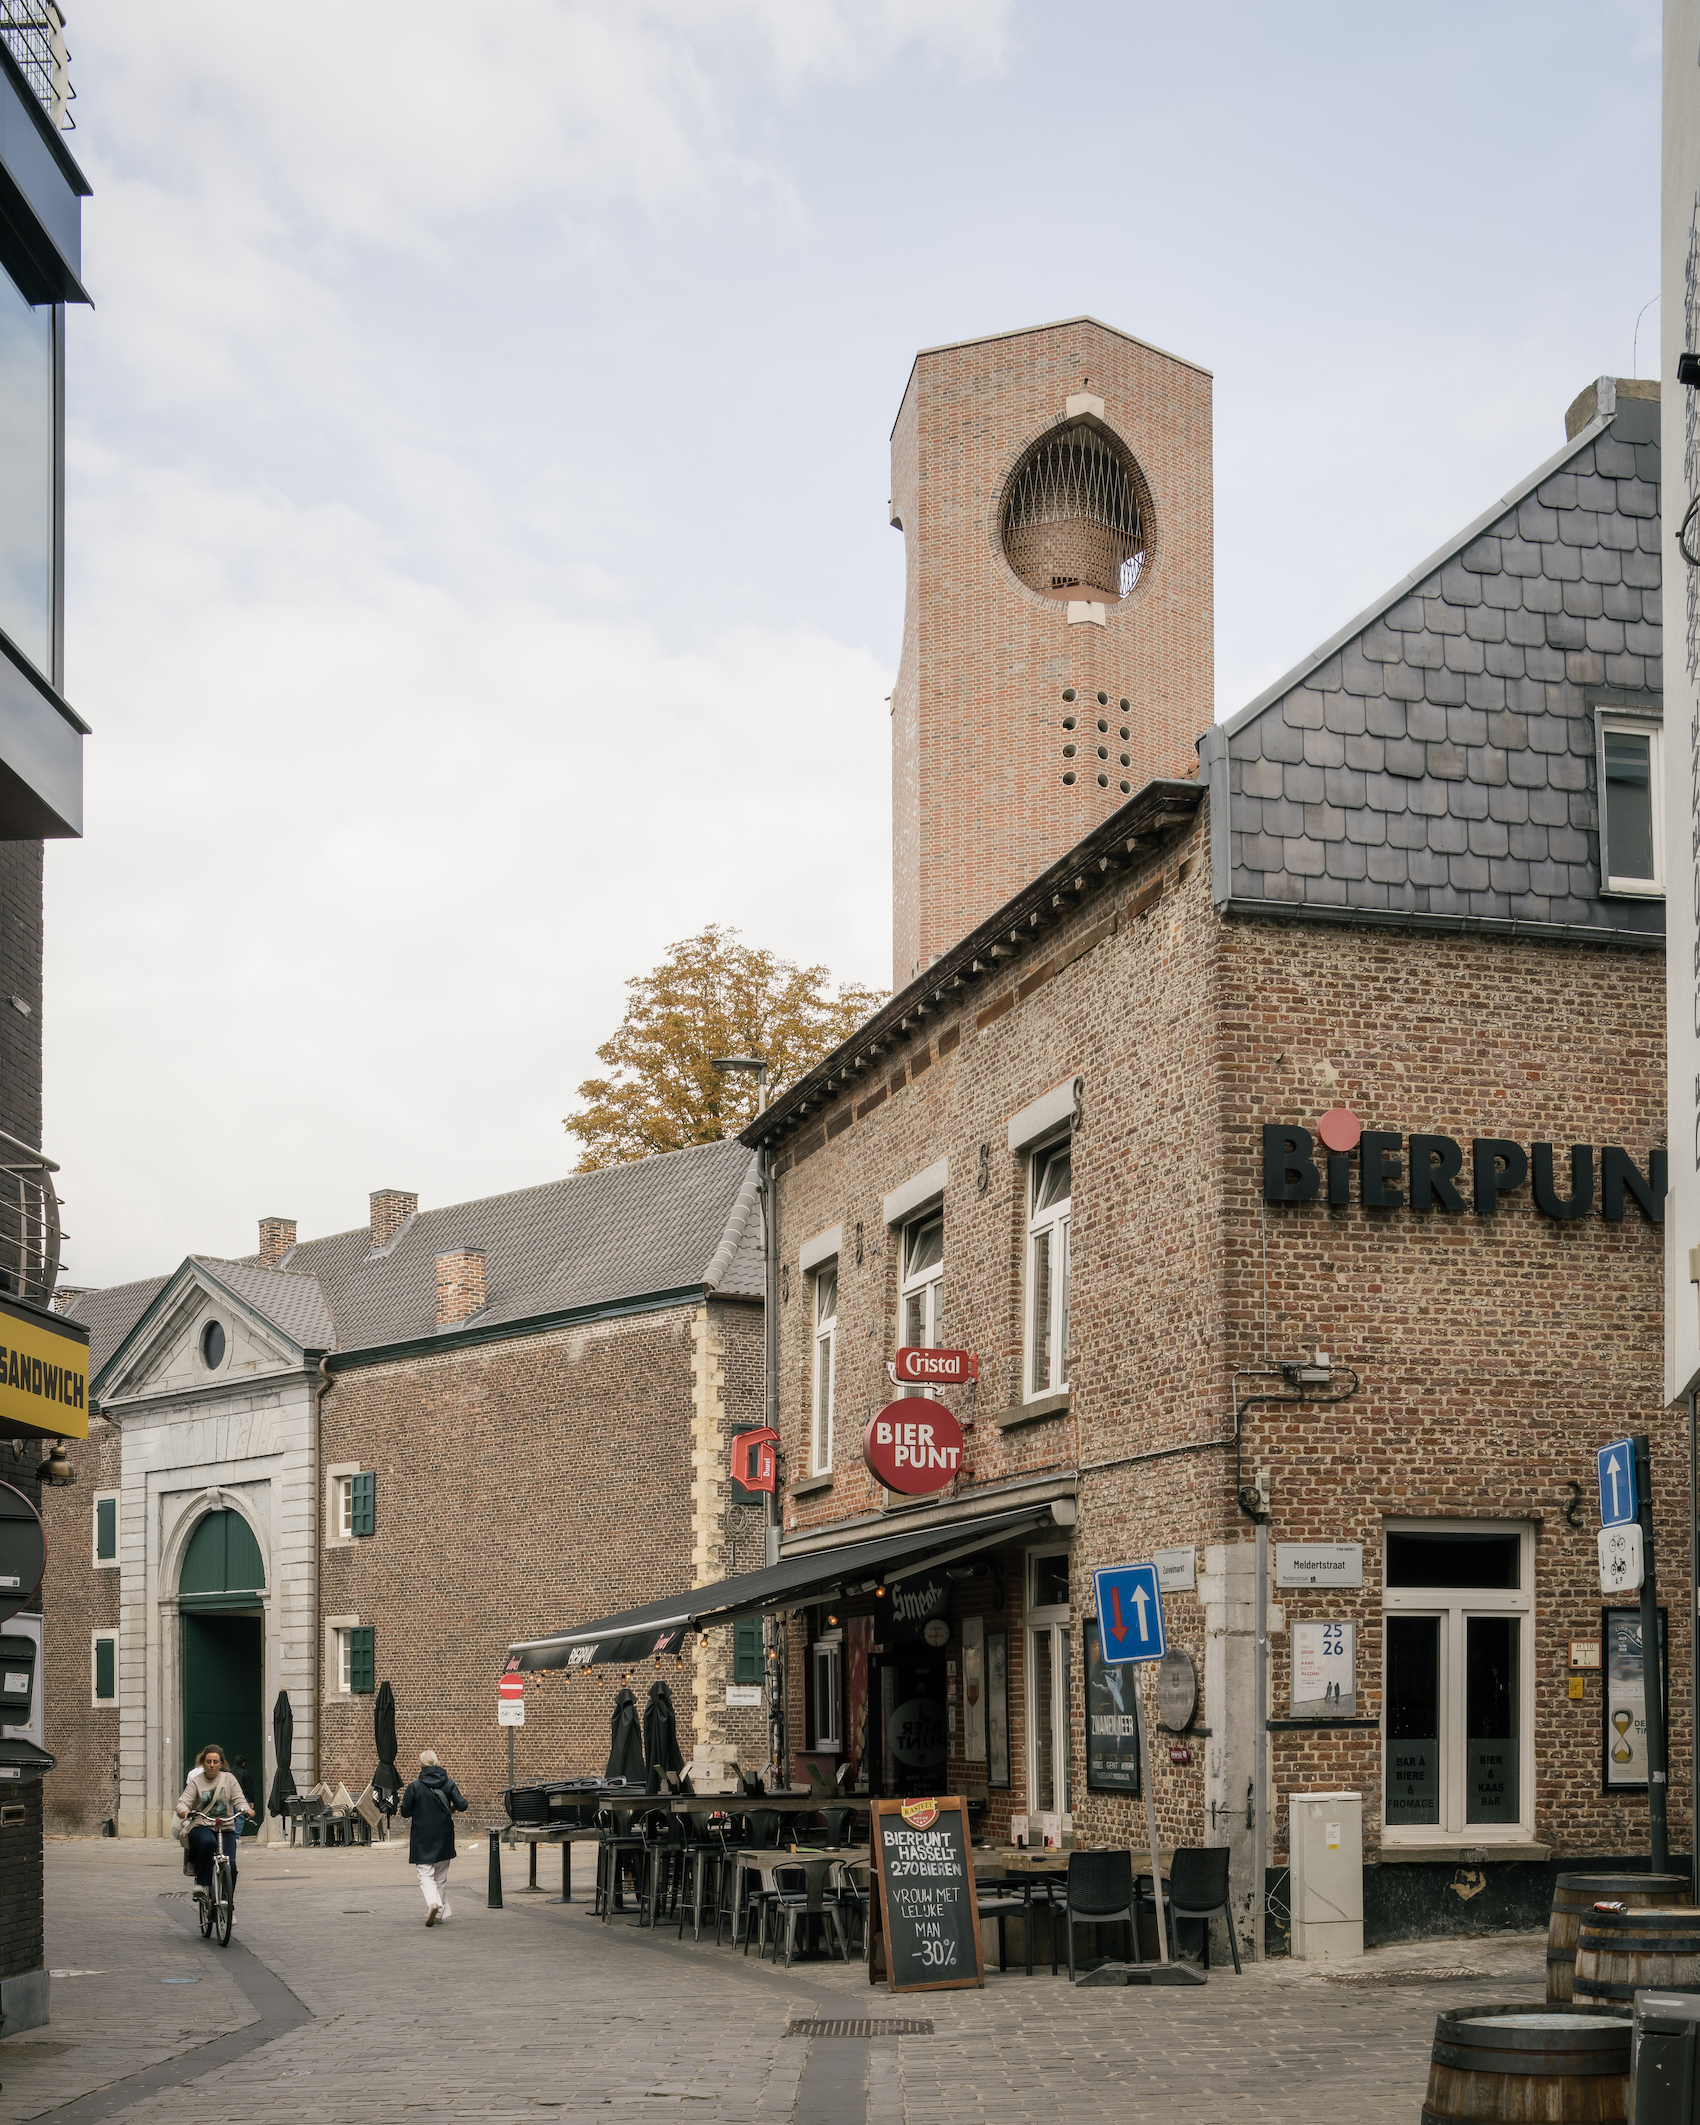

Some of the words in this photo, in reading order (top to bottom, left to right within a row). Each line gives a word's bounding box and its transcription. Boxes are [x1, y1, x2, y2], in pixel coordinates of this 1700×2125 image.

[905, 1352, 960, 1376] Cristal
[0, 1345, 84, 1410] SANDWICH
[876, 1422, 935, 1447] BIER
[894, 1445, 960, 1469] PUNT
[1162, 1564, 1185, 1575] Zuivelmarkt
[1293, 1560, 1346, 1570] Meldertstraat
[1322, 1624, 1343, 1638] 25
[1614, 1626, 1636, 1639] cinema
[1322, 1640, 1344, 1656] 26
[1105, 1761, 1119, 1770] GENT
[1396, 1757, 1416, 1767] BAR
[1480, 1755, 1503, 1765] BIER
[1487, 1769, 1495, 1779] &
[1407, 1785, 1415, 1795] &
[1478, 1783, 1504, 1793] KAAS
[903, 1801, 934, 1816] KASTEEL
[1387, 1799, 1434, 1809] FROMAGE
[1481, 1797, 1502, 1807] BAR
[883, 1830, 952, 1847] BIERPUNT
[898, 1845, 957, 1861] HASSELT
[892, 1888, 932, 1904] VROUW
[936, 1887, 961, 1902] MET
[915, 1922, 941, 1938] MAN
[911, 1938, 957, 1966] -30%
